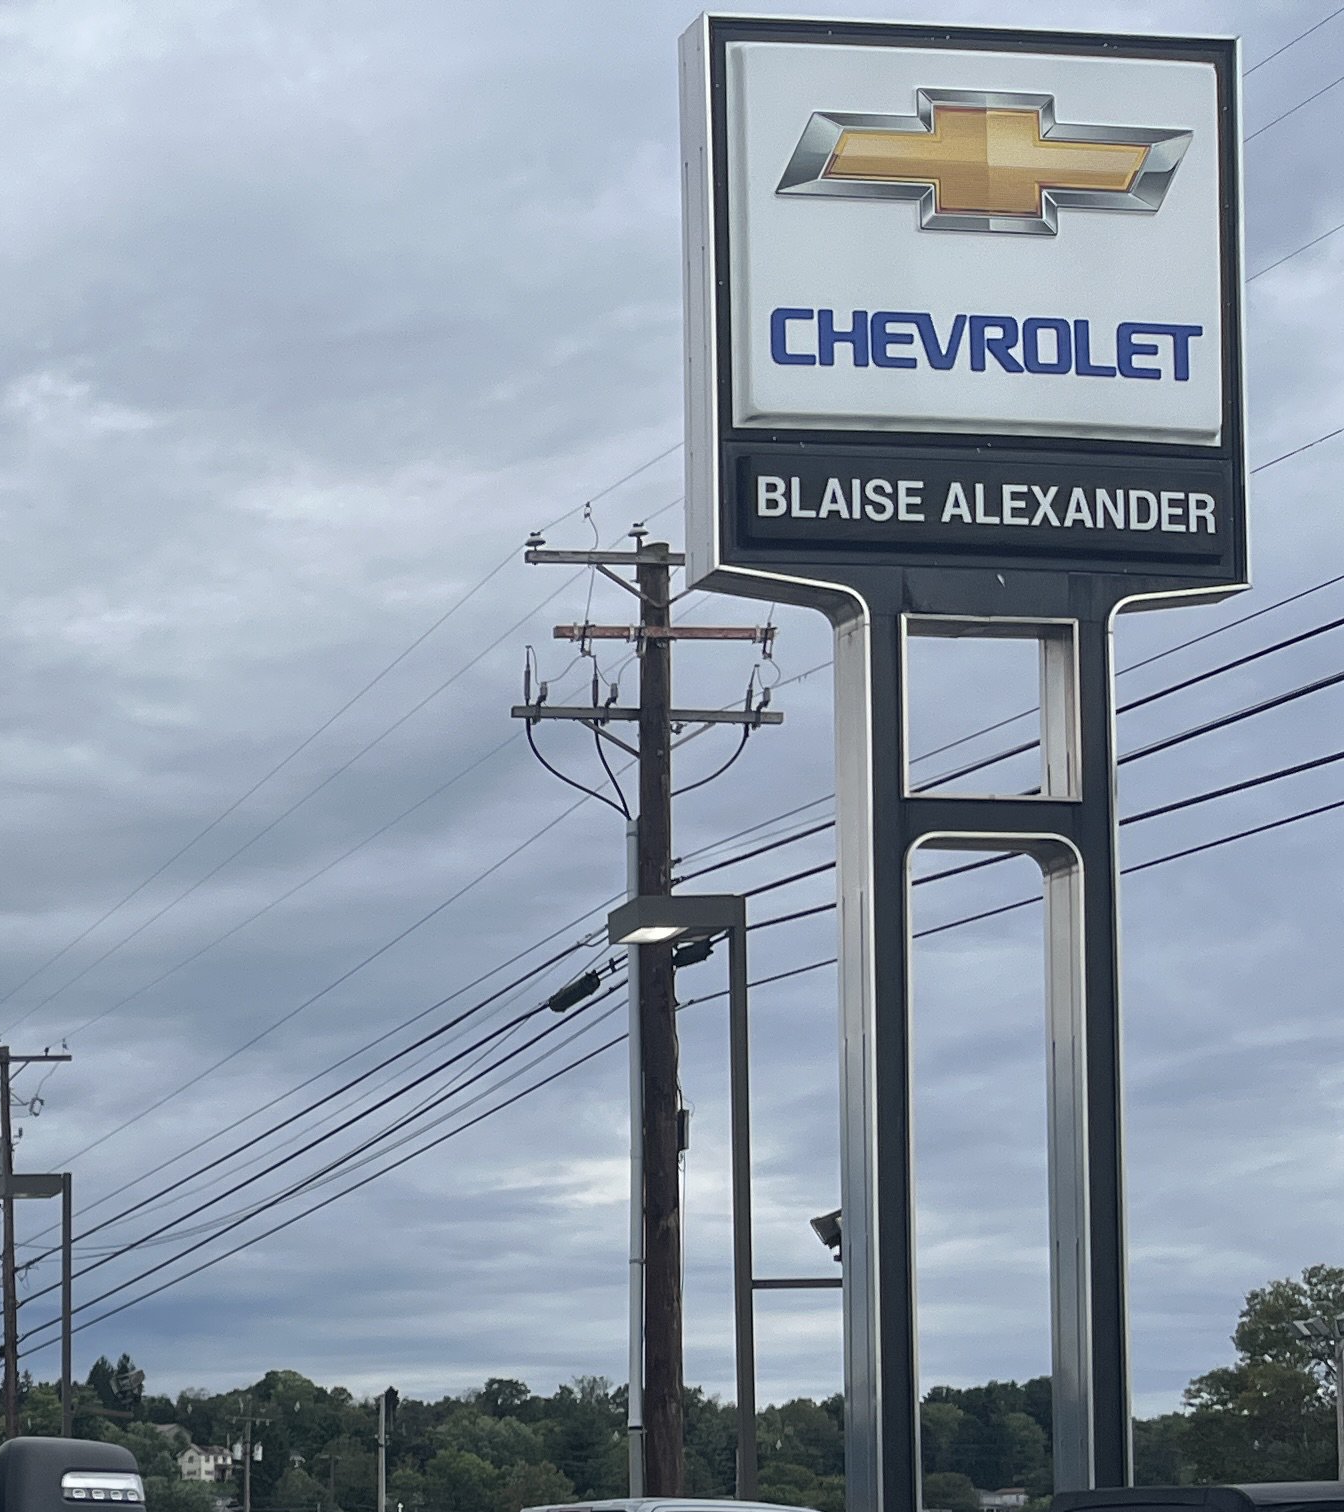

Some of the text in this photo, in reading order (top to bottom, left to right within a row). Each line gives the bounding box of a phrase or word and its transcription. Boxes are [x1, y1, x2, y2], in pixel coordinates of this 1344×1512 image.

[770, 307, 1204, 382] CHEVROLET
[756, 474, 1217, 535] BLAISE ALEXANDER
